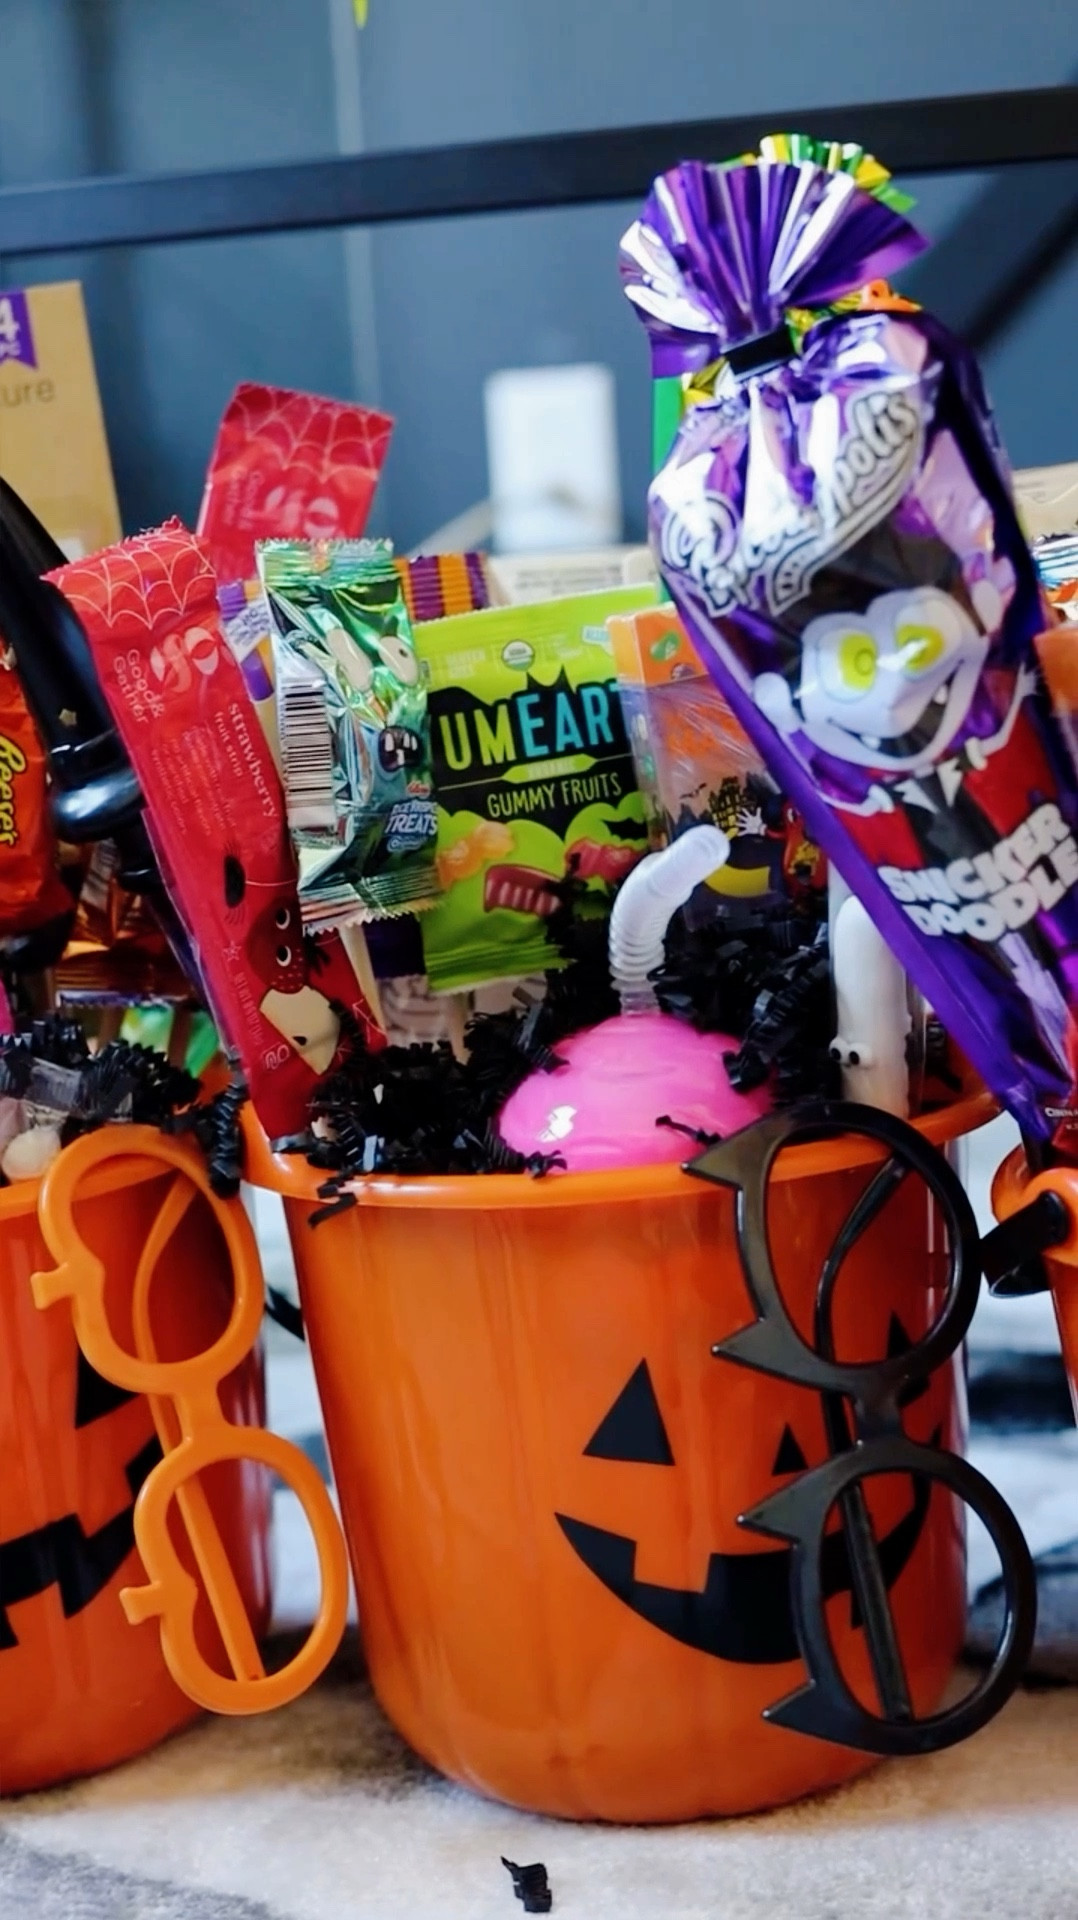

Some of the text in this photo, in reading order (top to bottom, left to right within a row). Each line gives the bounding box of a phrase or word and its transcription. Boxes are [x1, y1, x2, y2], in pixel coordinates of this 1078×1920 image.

[113, 655, 150, 724] Gather
[214, 711, 244, 777] fruit strip
[228, 703, 278, 818] strawberry
[384, 812, 438, 836] TREATS
[486, 771, 622, 818] GUMMY FRUITS
[877, 803, 1071, 904] SNICKER
[902, 835, 1078, 942] DOODLE
